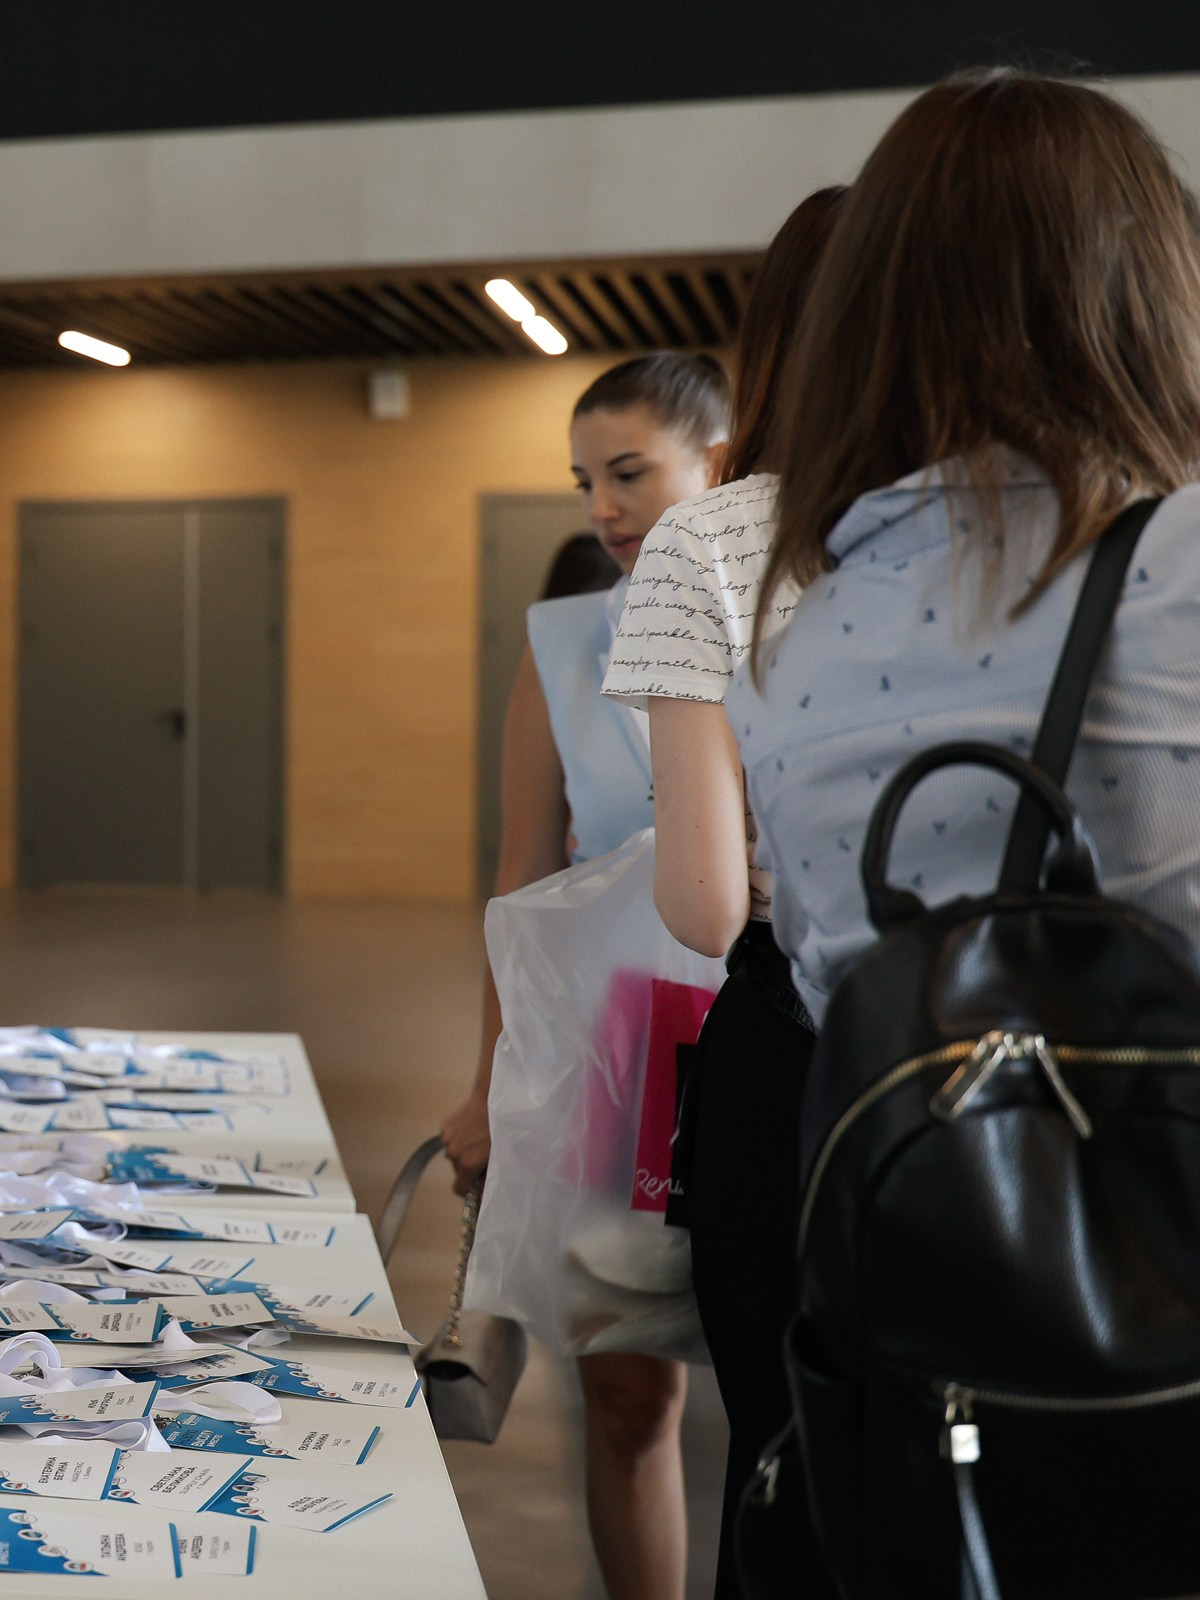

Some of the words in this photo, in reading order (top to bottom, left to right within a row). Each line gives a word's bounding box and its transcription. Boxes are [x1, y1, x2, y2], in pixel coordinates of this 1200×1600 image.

[96, 1391, 115, 1415] ВИНОГРАДОВ
[191, 1429, 214, 1447] ВЫСОТУ
[298, 1431, 318, 1451] ЕКАТЕРИНА
[38, 1456, 57, 1483] ЕКАТЕРИНА
[53, 1461, 69, 1480] БЕТИНА
[150, 1466, 185, 1491] СВЕТЛАНА
[161, 1466, 198, 1493] БЕЛИКОВА
[100, 1534, 111, 1558] ТАТЬЯНА
[115, 1533, 126, 1561] АНДРЕЕВА
[191, 1535, 203, 1559] АНДРЕЕВА
